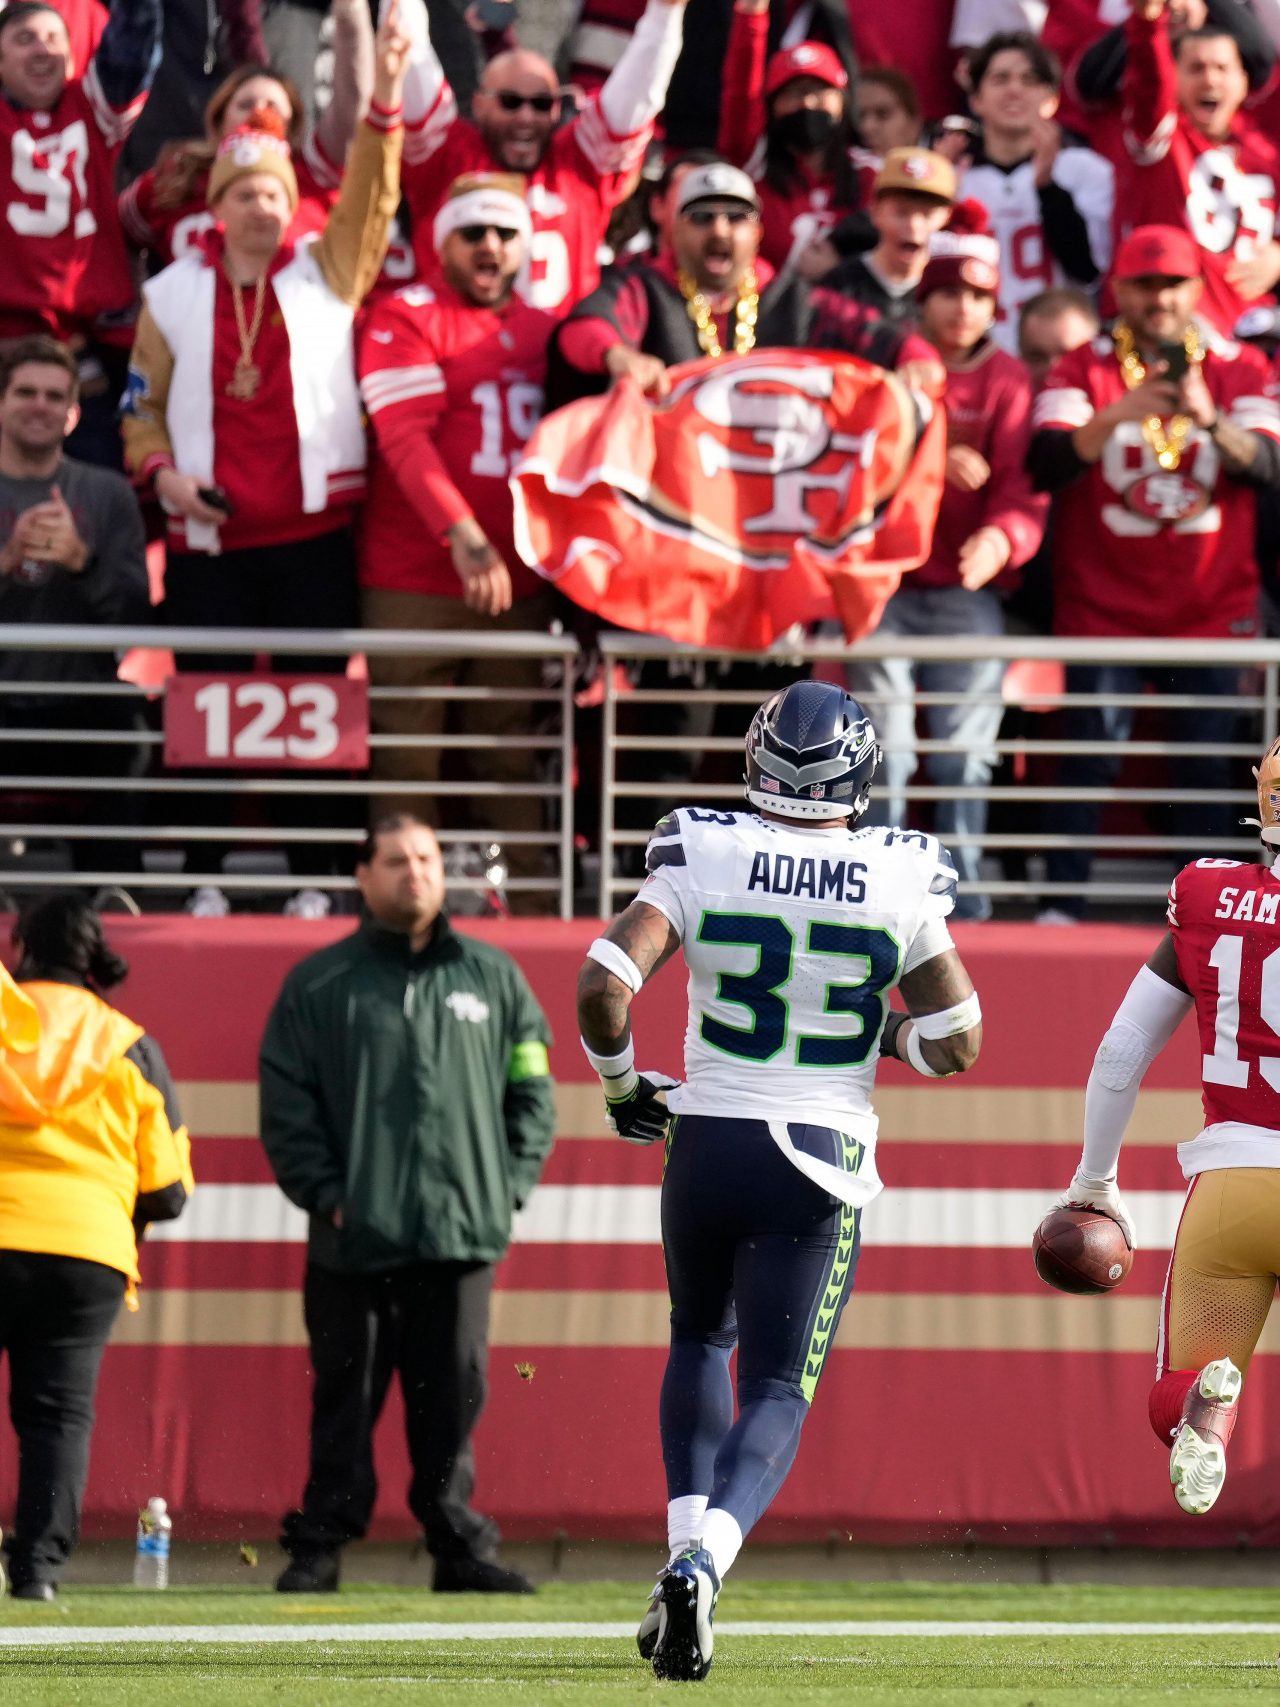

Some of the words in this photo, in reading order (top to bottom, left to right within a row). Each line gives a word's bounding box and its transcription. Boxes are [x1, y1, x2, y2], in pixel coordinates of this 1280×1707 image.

[195, 682, 340, 759] 123
[763, 799, 829, 813] SEATTLE
[747, 851, 867, 904] ADAMS
[697, 910, 902, 1068] 33
